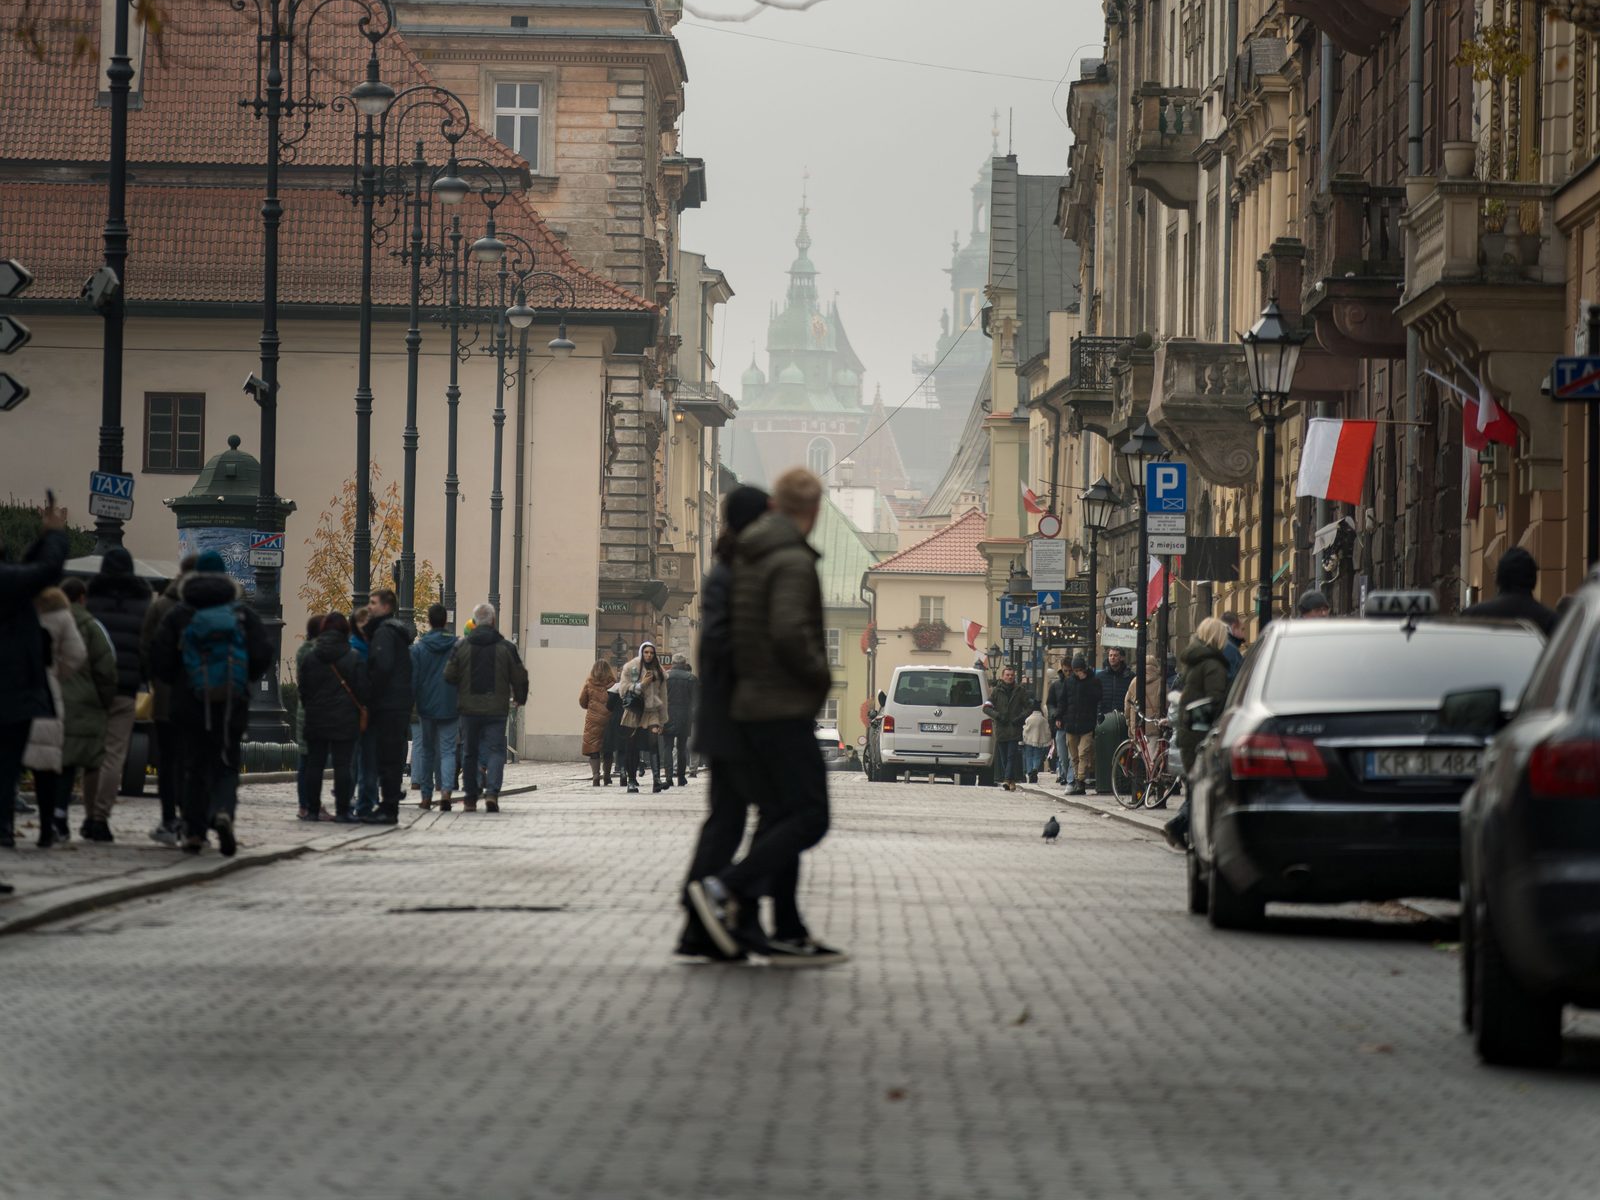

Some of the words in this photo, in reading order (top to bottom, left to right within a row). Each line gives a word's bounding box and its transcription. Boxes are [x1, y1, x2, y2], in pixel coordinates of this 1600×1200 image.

[1558, 363, 1600, 391] TA
[95, 475, 132, 497] TAXI
[1156, 467, 1178, 498] P
[252, 534, 282, 548] TAXI
[1157, 541, 1184, 550] miejsca
[1111, 608, 1133, 616] MASSAGE
[1376, 596, 1431, 610] TAXI
[1378, 752, 1407, 775] KR
